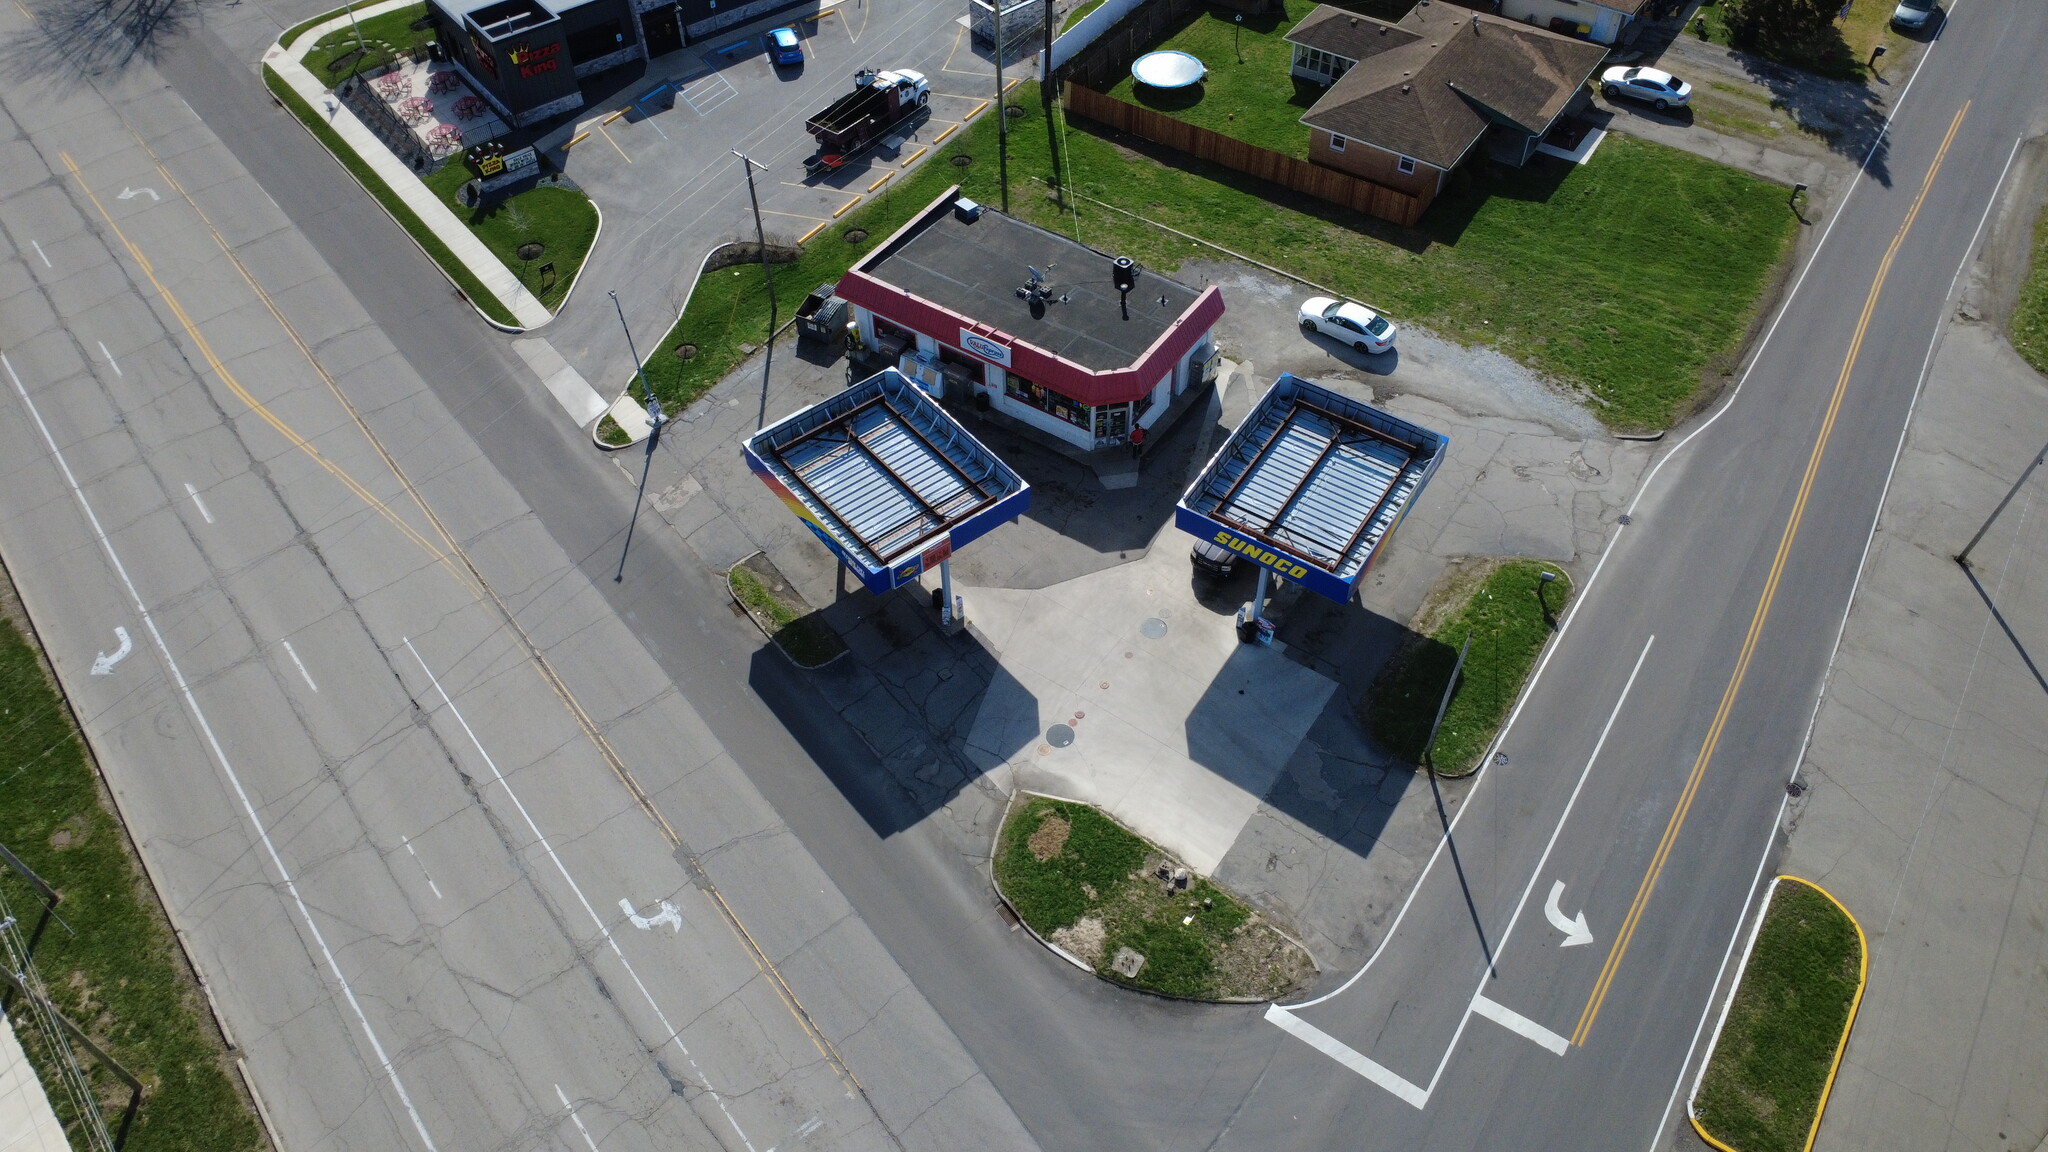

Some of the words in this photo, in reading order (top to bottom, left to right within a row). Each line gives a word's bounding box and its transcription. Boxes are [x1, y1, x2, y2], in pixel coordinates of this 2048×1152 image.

[517, 43, 561, 65] Pizza
[519, 58, 559, 80] King
[482, 159, 500, 170] PIZZA
[484, 164, 501, 174] KING
[1213, 531, 1308, 579] SUNOCO
